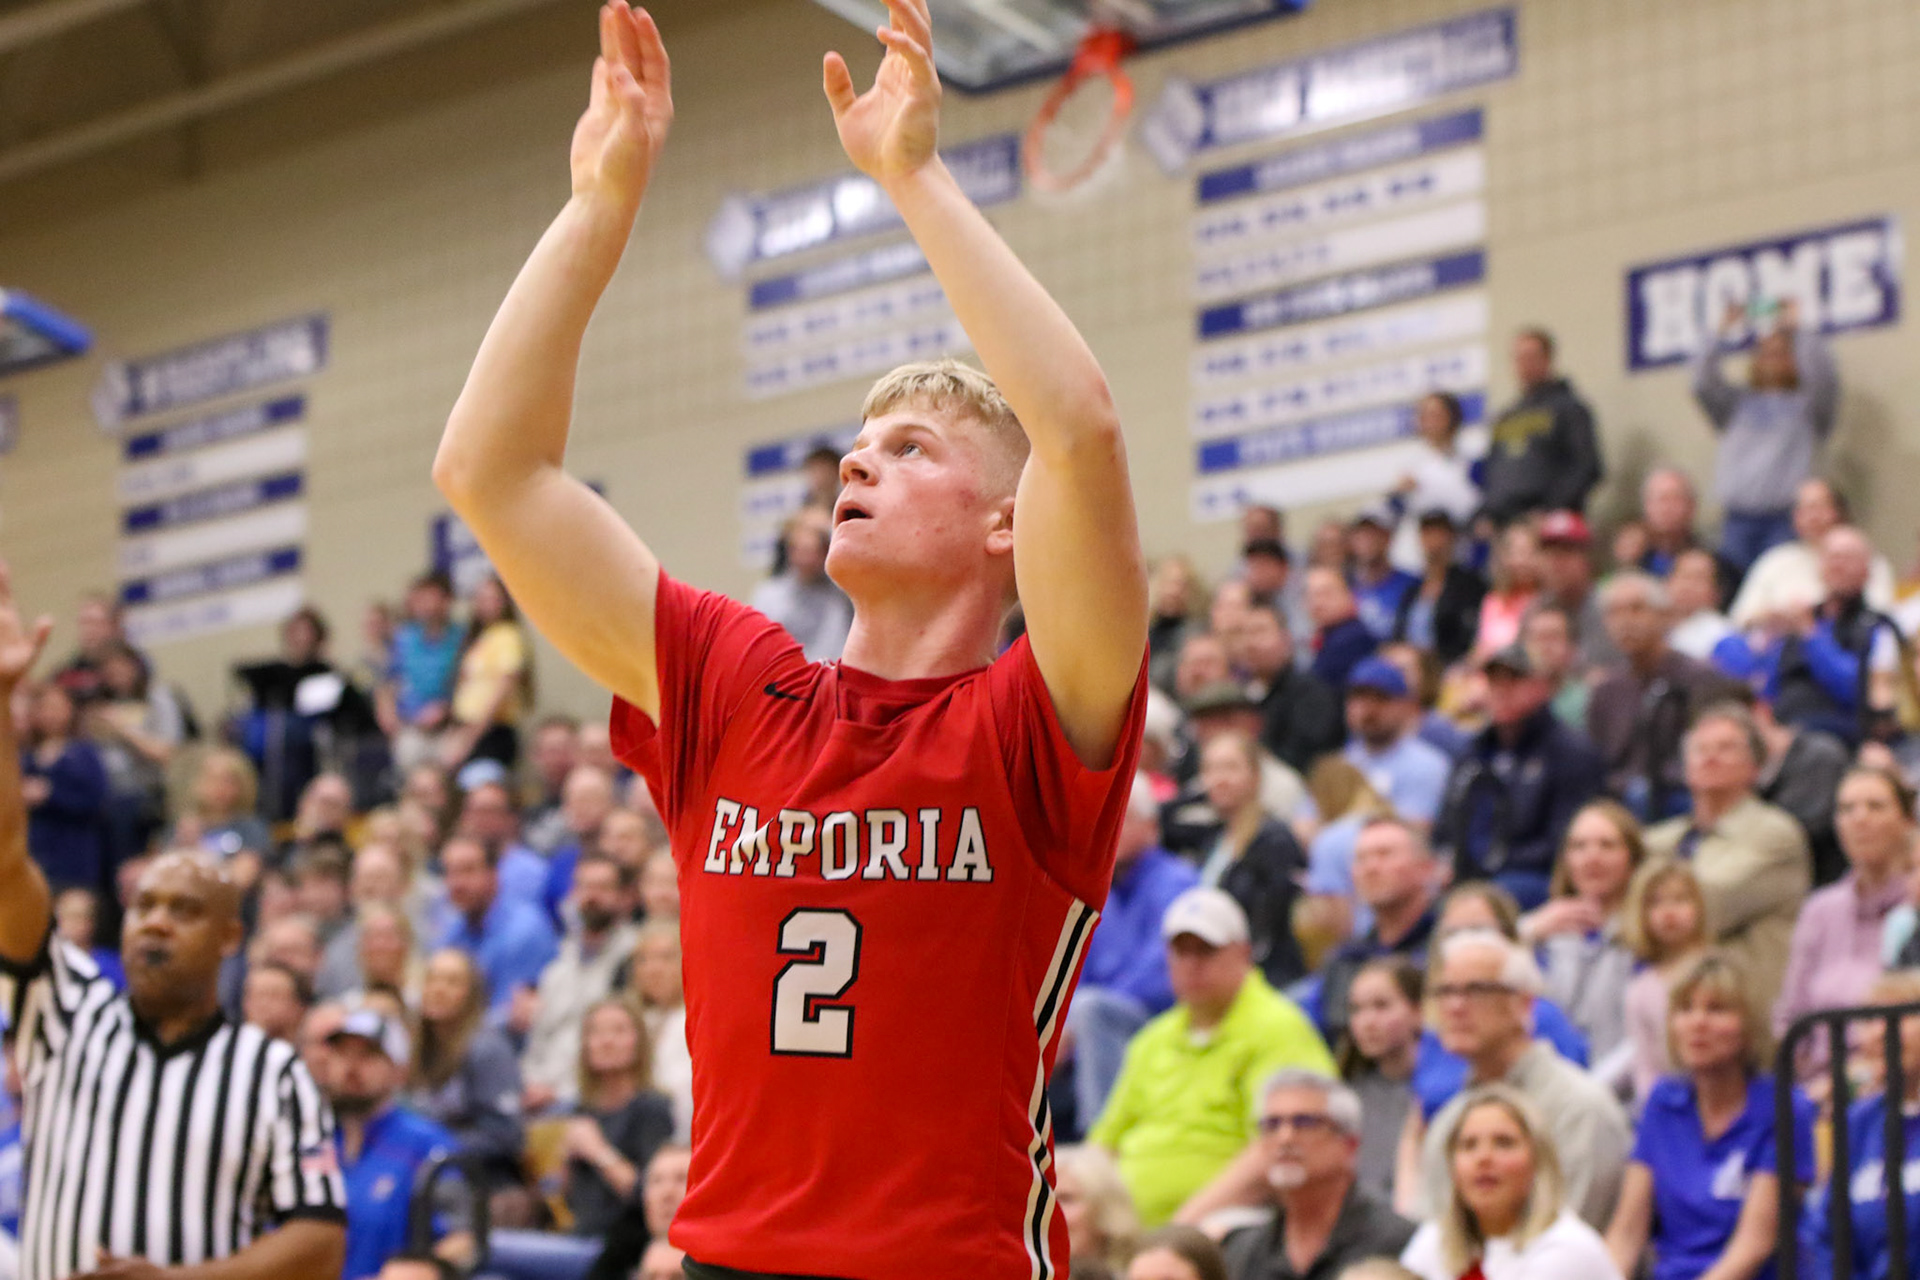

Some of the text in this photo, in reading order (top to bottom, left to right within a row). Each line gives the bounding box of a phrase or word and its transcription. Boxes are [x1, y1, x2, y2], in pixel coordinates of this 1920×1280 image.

[1642, 230, 1883, 360] HOME
[703, 797, 993, 881] EMPORIA
[770, 907, 863, 1058] 2
